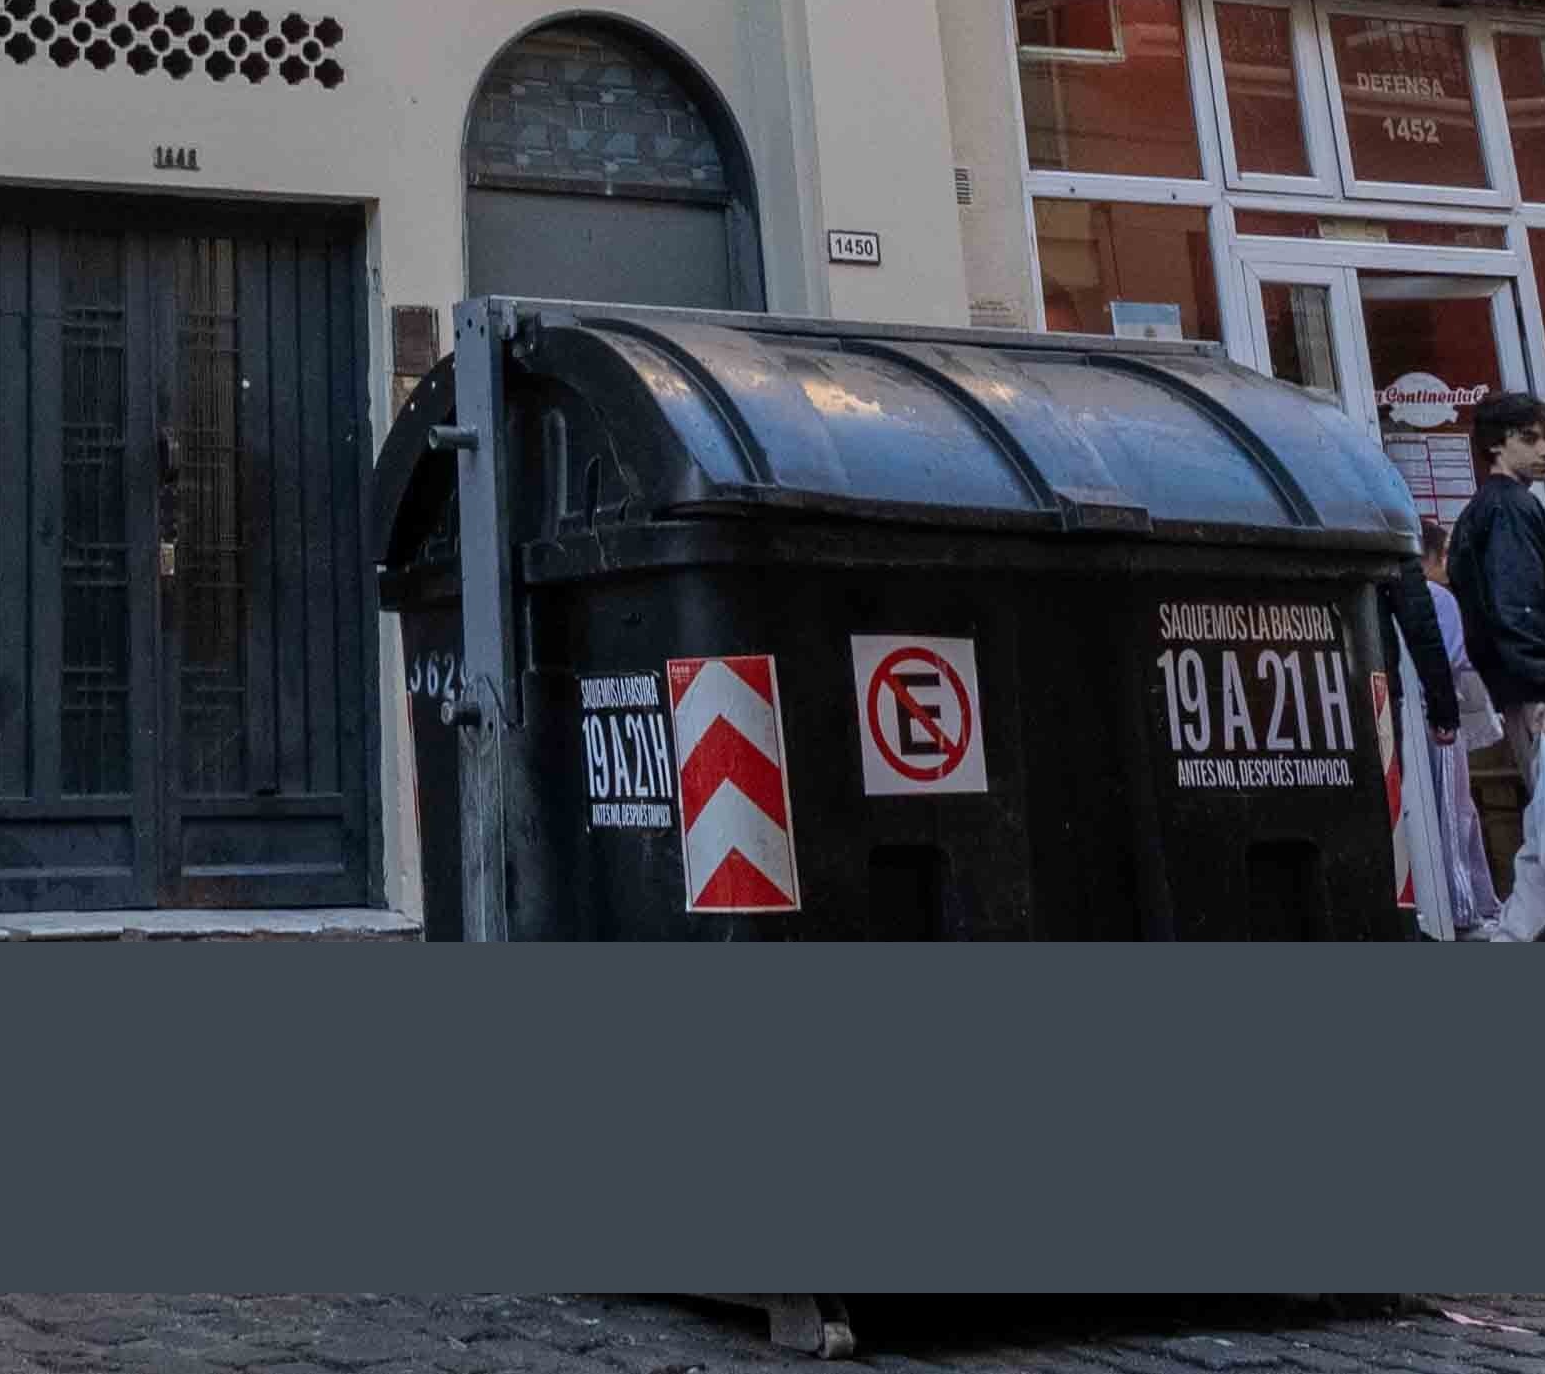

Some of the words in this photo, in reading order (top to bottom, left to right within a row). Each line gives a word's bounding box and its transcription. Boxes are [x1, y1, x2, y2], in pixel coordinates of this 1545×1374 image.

[1355, 71, 1445, 99] DEFENSA
[1381, 116, 1442, 145] 1452
[834, 237, 874, 257] 1450
[1159, 603, 1248, 642] SAQUEMOS
[1250, 604, 1270, 640] LA
[1270, 604, 1335, 642] BASURA
[580, 677, 618, 710] SAQUEMOS
[626, 675, 660, 707] BASURA
[1156, 648, 1211, 752] 19
[1221, 651, 1258, 751] A
[1257, 649, 1311, 751] 21
[1314, 652, 1355, 751] H
[581, 713, 610, 799] 19
[609, 714, 632, 798] A
[624, 713, 657, 798] 21
[648, 712, 674, 798] H
[1177, 758, 1217, 788] ANTES
[1217, 758, 1240, 791] NO,
[1240, 753, 1294, 788] DESPUÉS
[1294, 758, 1355, 787] TAMPOCO.
